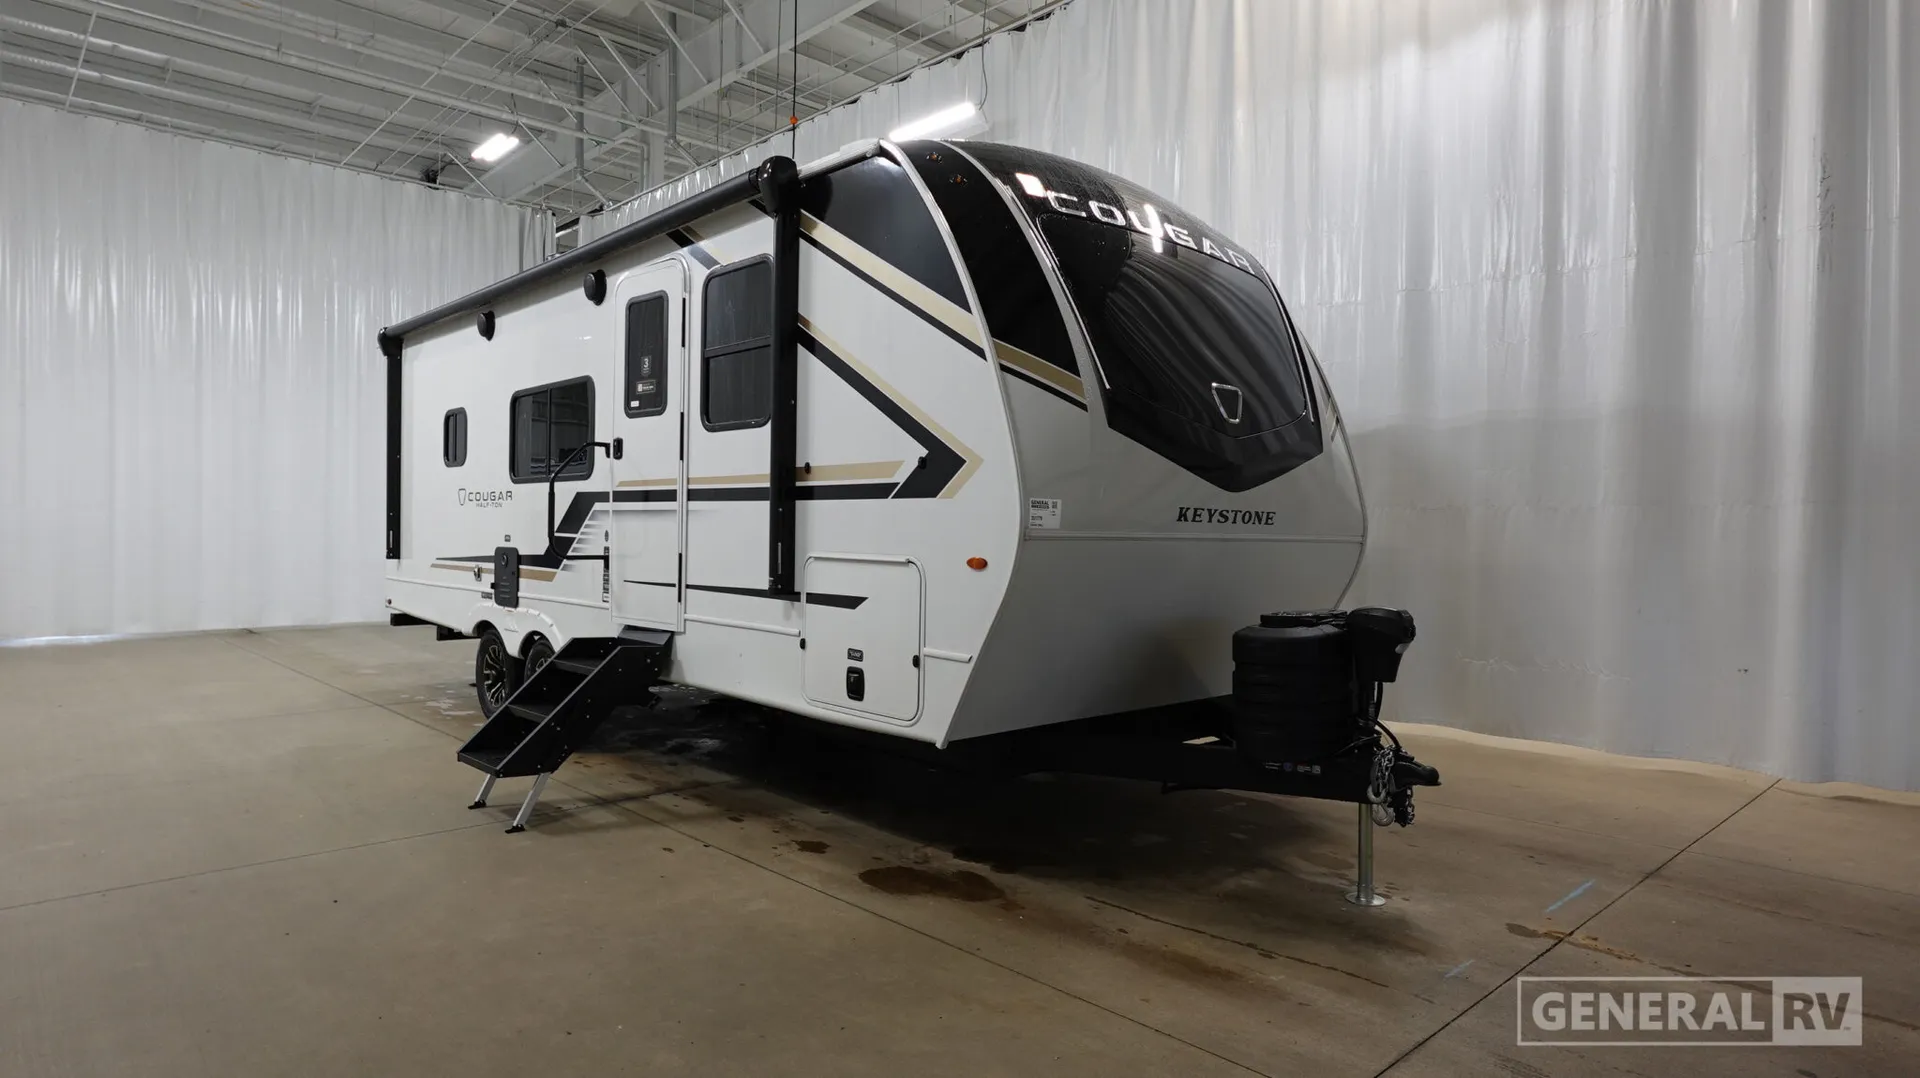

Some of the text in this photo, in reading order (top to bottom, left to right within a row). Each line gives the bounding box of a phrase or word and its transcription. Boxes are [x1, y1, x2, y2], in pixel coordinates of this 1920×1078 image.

[1046, 190, 1255, 274] COUGAR
[468, 490, 513, 502] COUGAR
[1176, 506, 1277, 526] KEYSTONE
